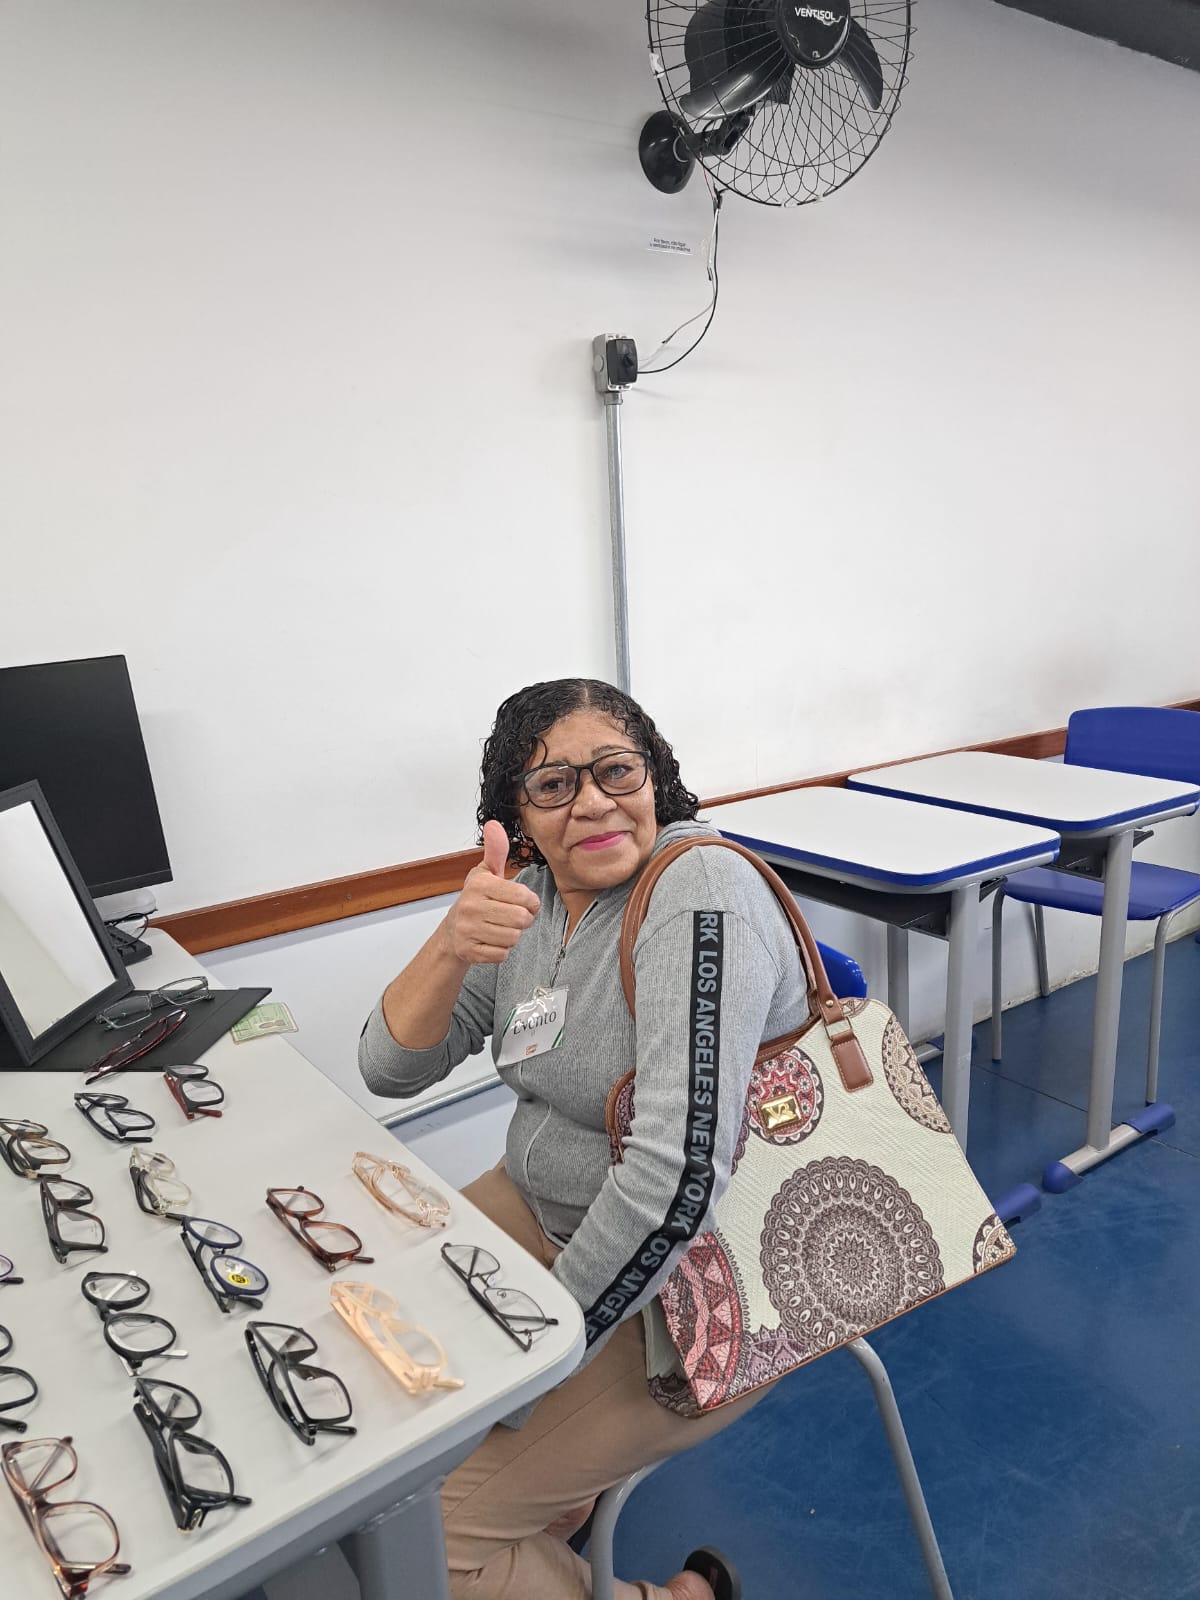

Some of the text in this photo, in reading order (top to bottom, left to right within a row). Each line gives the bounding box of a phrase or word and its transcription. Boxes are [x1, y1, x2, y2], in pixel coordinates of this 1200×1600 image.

[794, 7, 836, 21] VENTISOL
[697, 950, 718, 993] LOS
[513, 1010, 557, 1035] Evento
[694, 997, 716, 1105] ANGELES
[690, 1111, 712, 1166] NEW
[671, 1170, 711, 1235] YORK
[641, 1232, 671, 1267] OS
